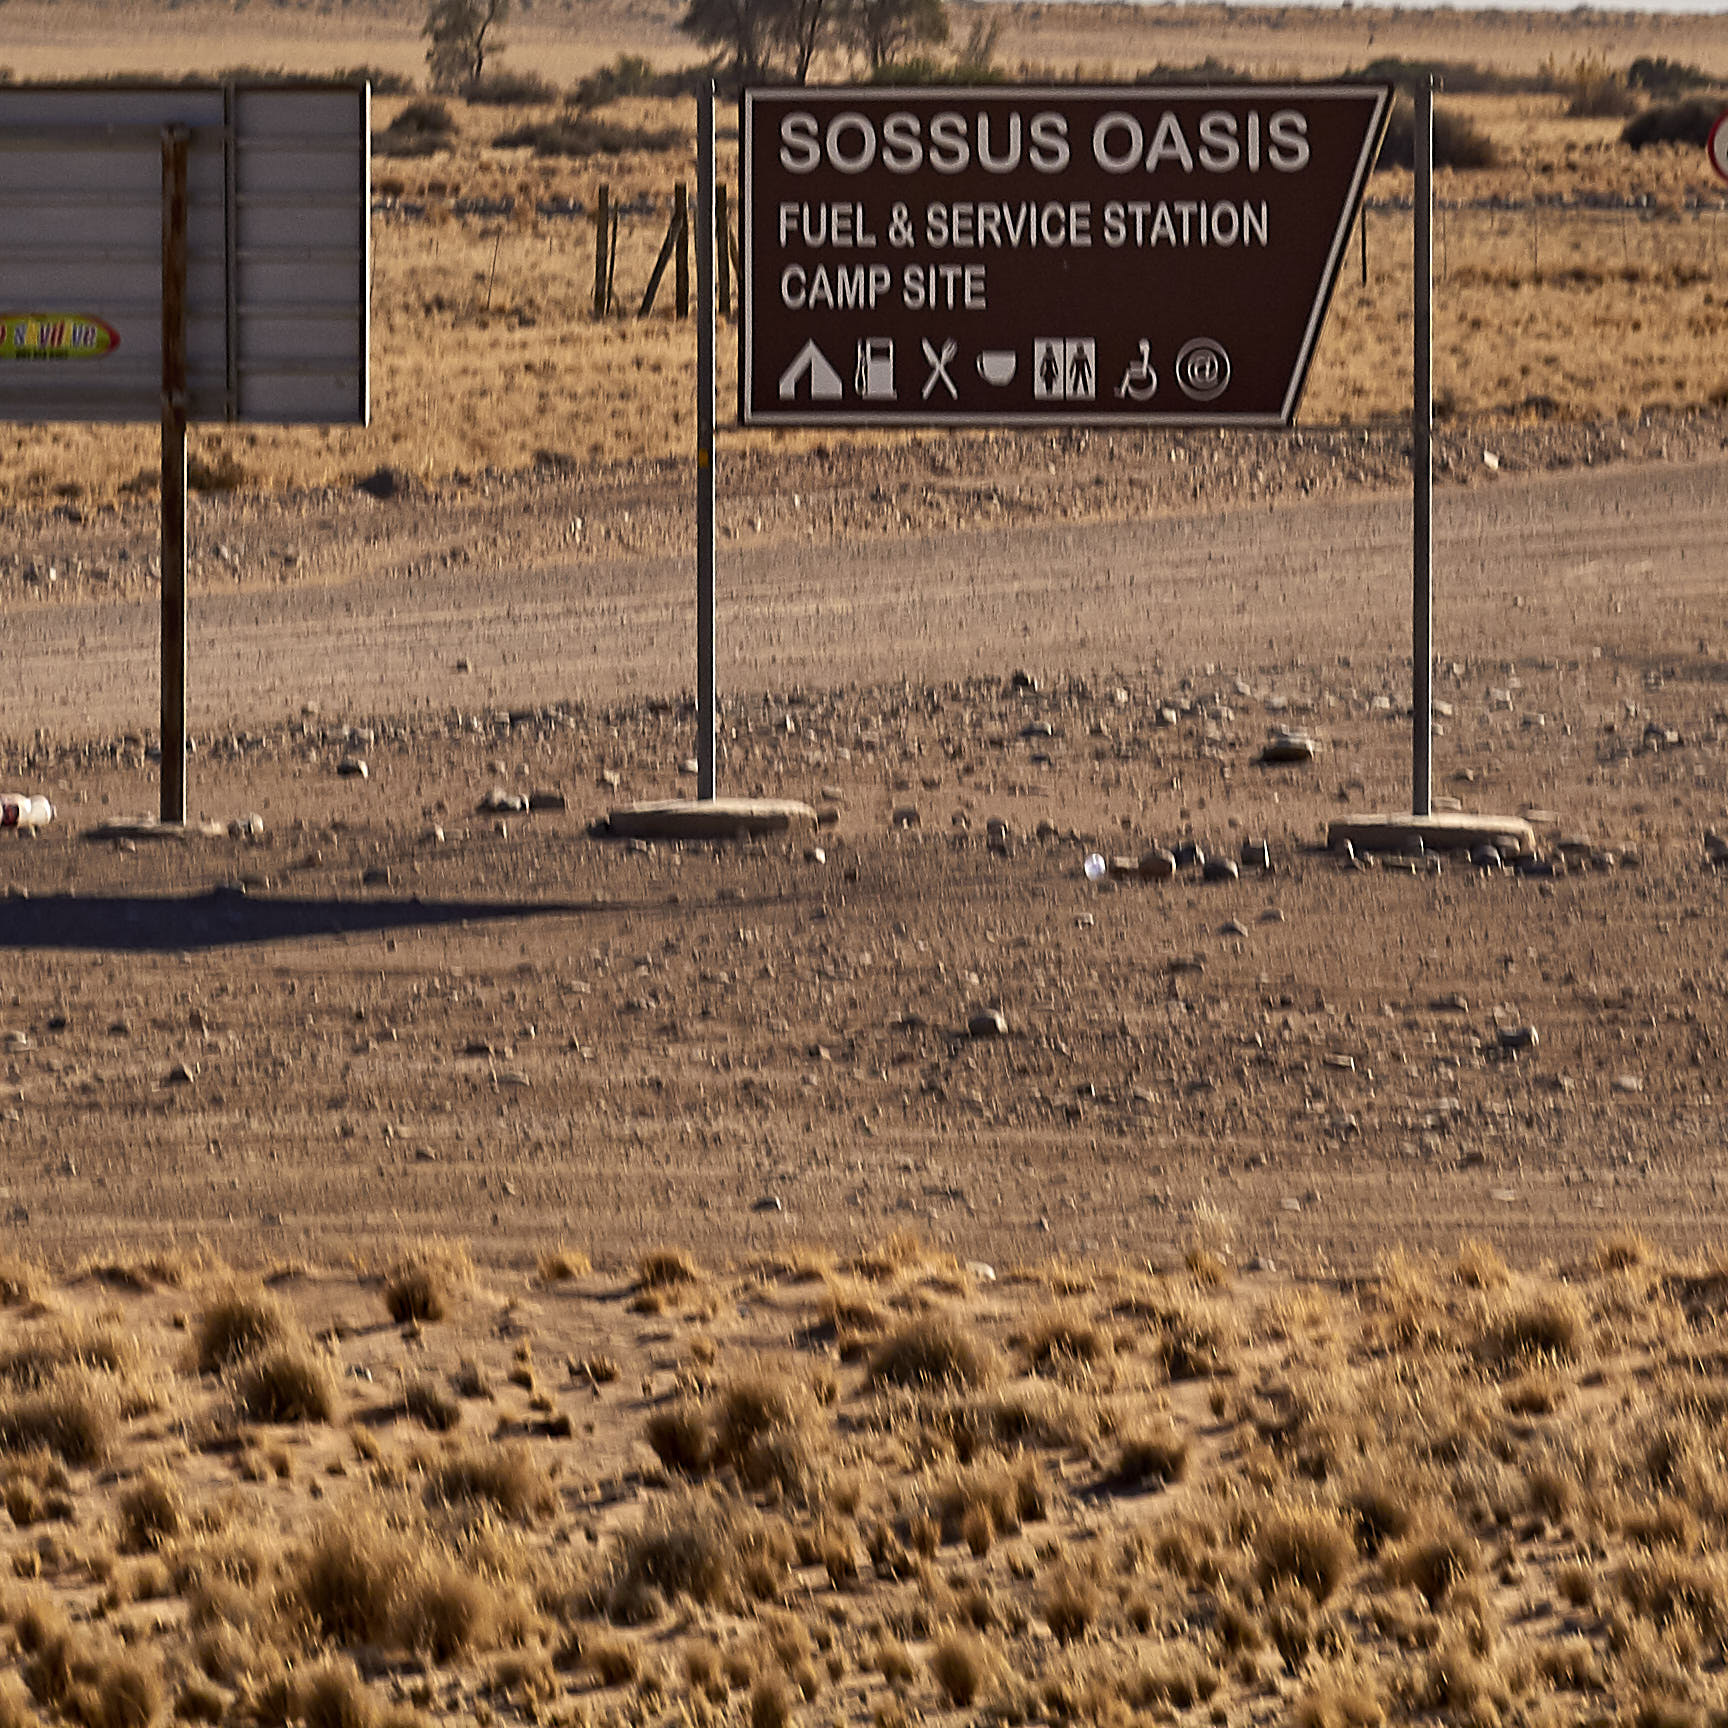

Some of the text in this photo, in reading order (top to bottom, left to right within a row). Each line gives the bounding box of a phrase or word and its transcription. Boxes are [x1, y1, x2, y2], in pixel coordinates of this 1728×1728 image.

[778, 110, 1311, 173] SOSSUS OASIS
[778, 200, 1269, 248] FUEL & SERVICE STATION
[780, 263, 988, 311] CAMP SITE
